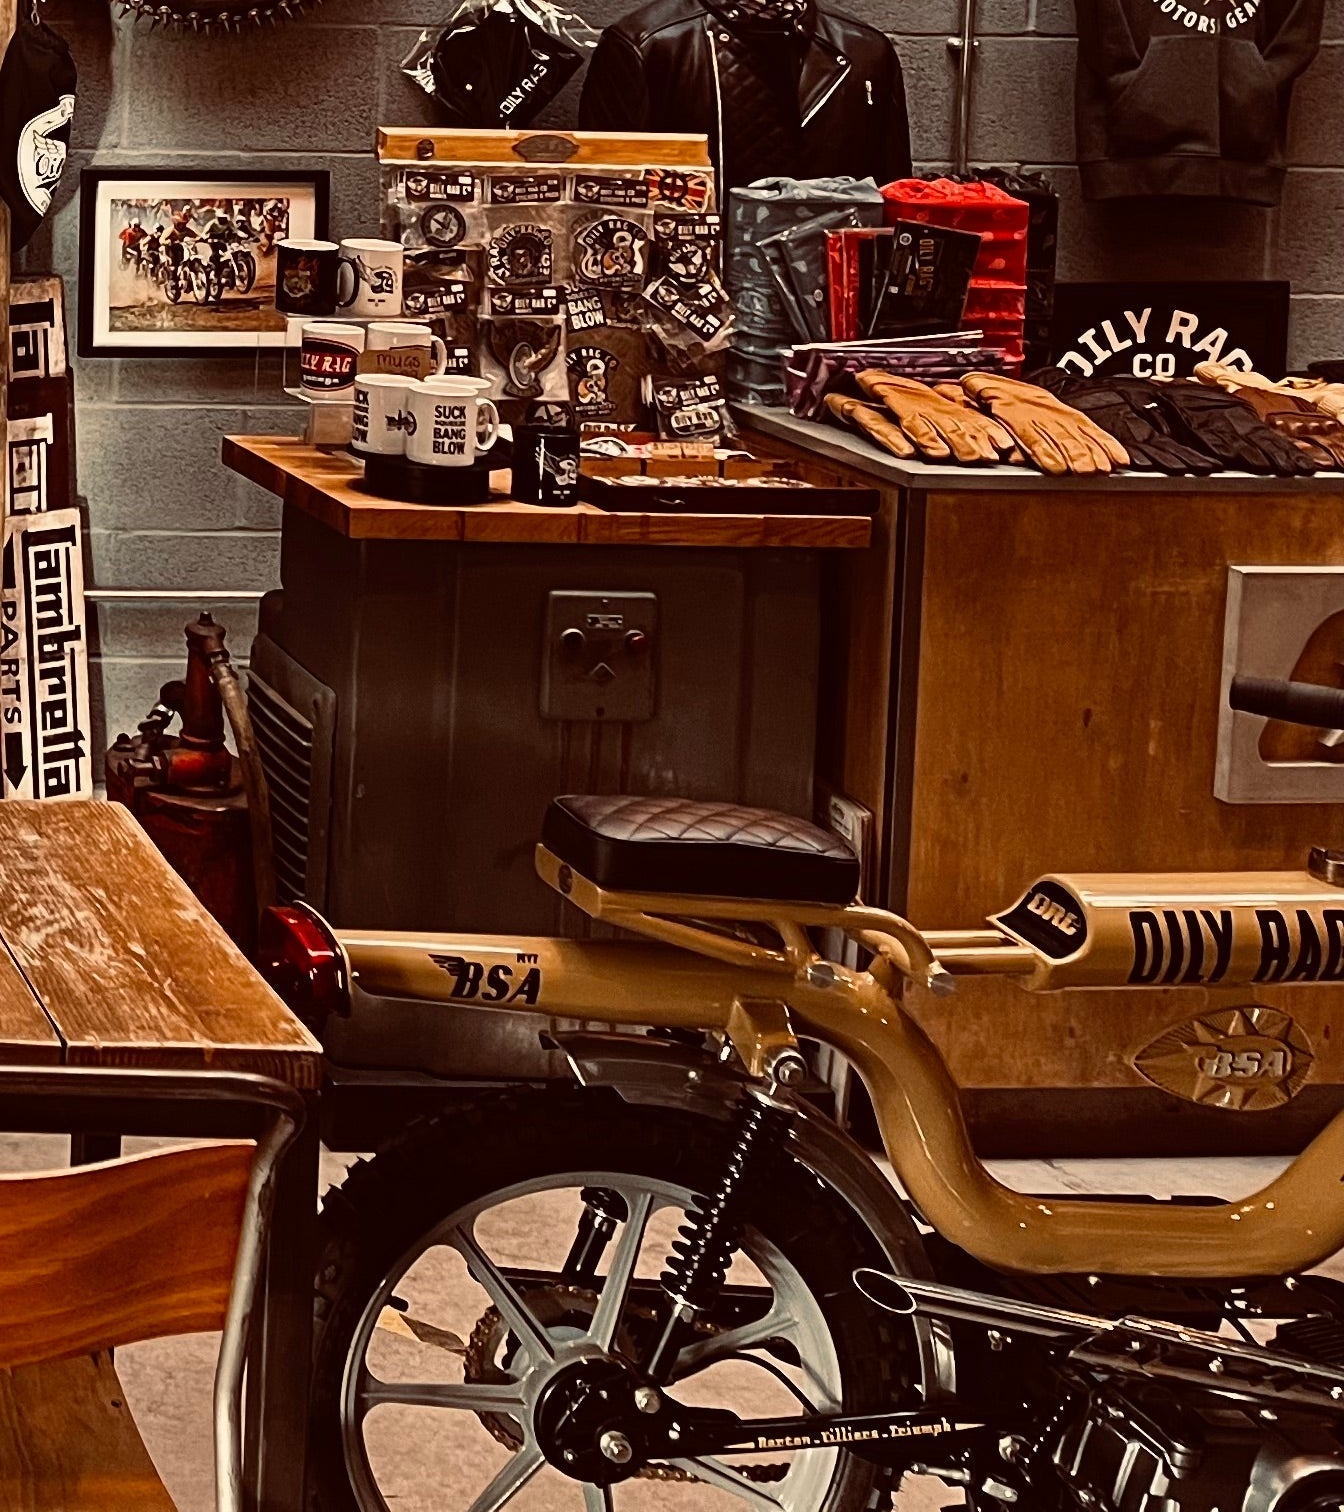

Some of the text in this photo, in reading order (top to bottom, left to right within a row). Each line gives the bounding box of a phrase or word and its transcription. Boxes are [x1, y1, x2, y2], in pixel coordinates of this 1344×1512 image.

[499, 86, 526, 115] OILY
[567, 296, 602, 315] BANG
[570, 310, 605, 330] BLOW
[322, 356, 352, 373] RAG
[1132, 352, 1176, 379] CO
[434, 404, 467, 420] SUCK
[432, 440, 465, 455] BLOW
[433, 427, 467, 440] BANG
[0, 600, 22, 723] PARTS
[24, 524, 86, 800] Lambretta
[1026, 892, 1082, 936] ORC
[1127, 909, 1232, 984] OILY
[449, 961, 541, 1005] BSA
[1208, 1050, 1286, 1079] BSA
